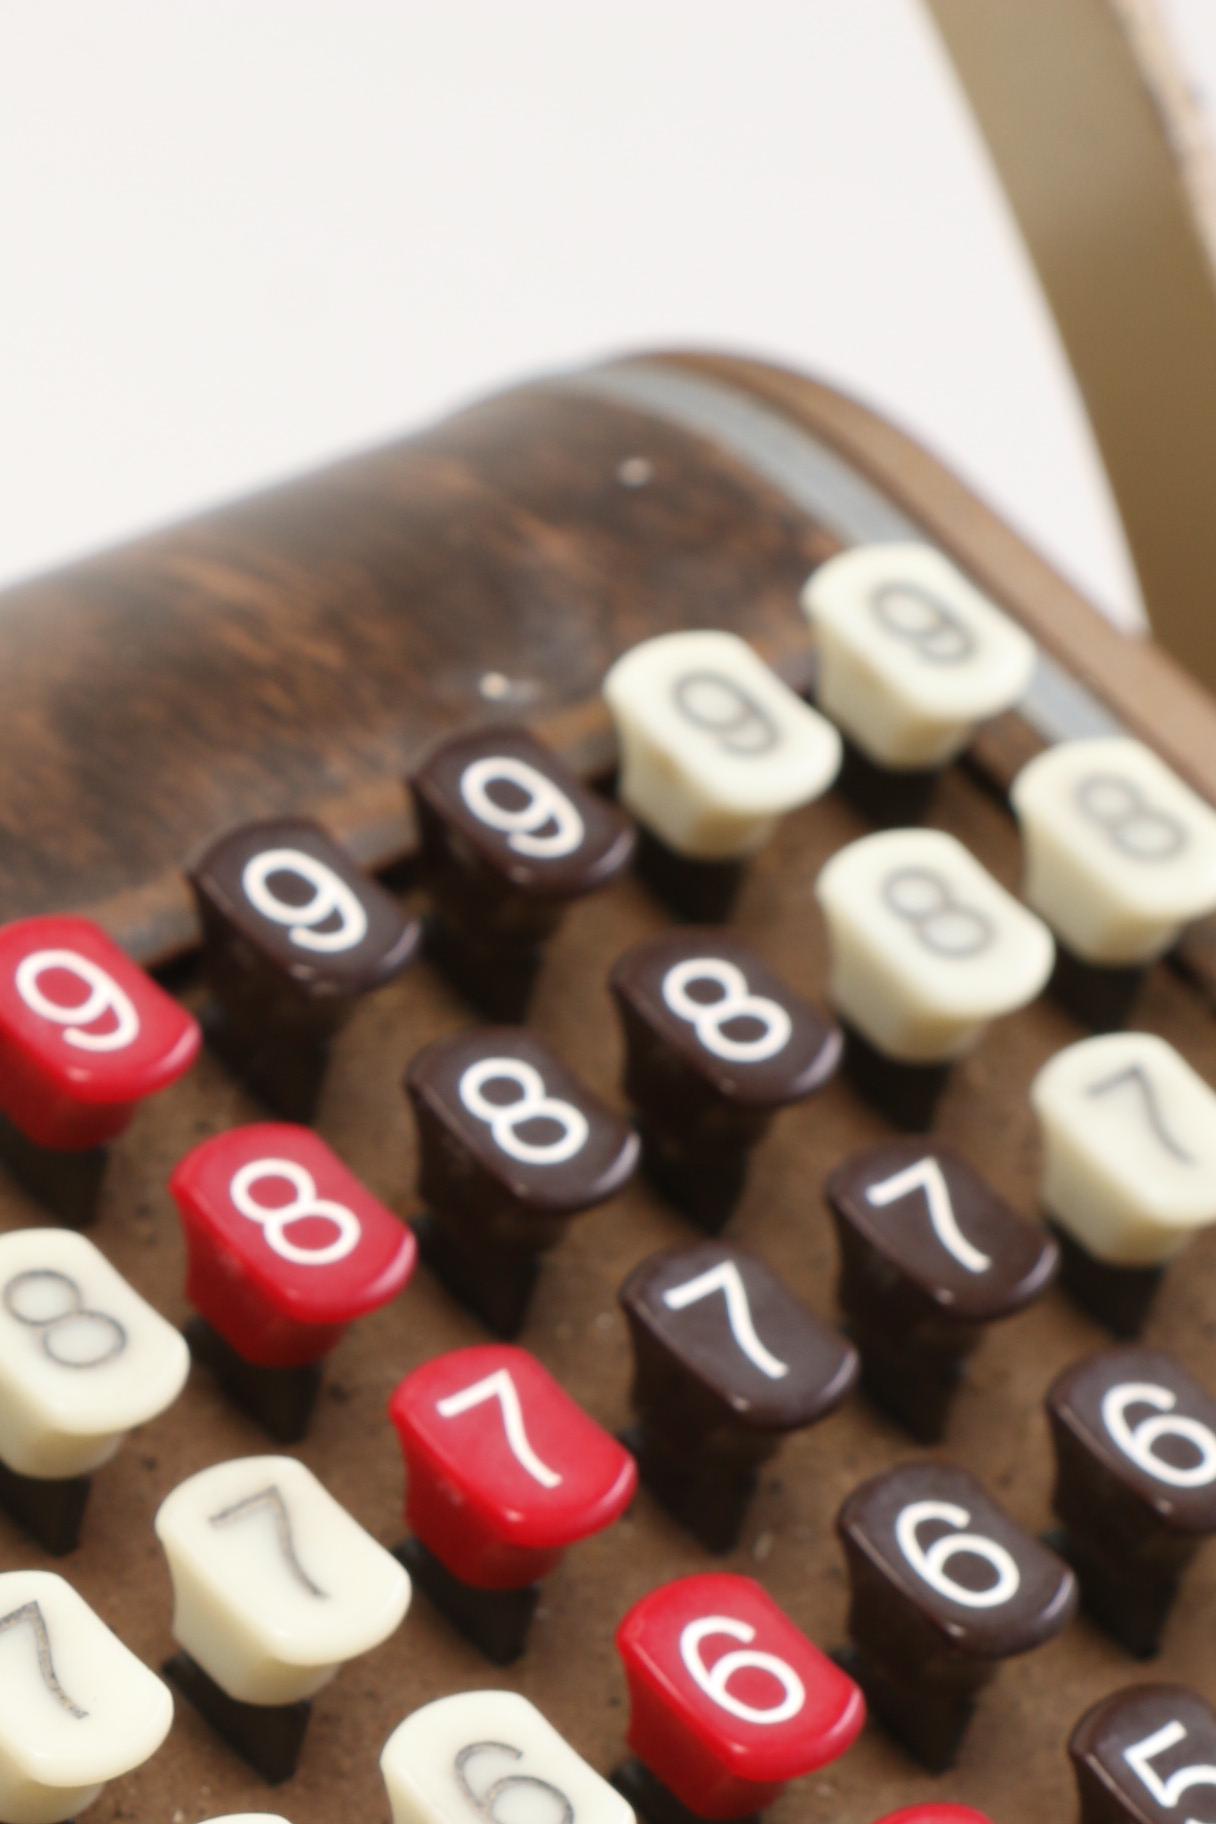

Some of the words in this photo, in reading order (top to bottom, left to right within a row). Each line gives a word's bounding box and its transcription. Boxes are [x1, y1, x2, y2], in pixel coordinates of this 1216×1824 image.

[866, 580, 978, 668] 9
[671, 669, 783, 758] 9
[462, 758, 582, 856] 9
[1071, 775, 1193, 863] 8
[244, 850, 366, 951] 9
[879, 866, 998, 960] 8
[16, 951, 138, 1050] 9
[664, 959, 790, 1061] 8
[460, 1059, 587, 1163] 8
[1085, 1061, 1194, 1166] 7
[231, 1159, 360, 1264] 8
[867, 1160, 987, 1271] 7
[2, 1268, 128, 1370] 8
[665, 1263, 786, 1377] 7
[438, 1370, 560, 1487] 7
[208, 1484, 329, 1601] 7
[897, 1502, 1018, 1607] 6
[0, 1600, 89, 1720] 7
[681, 1617, 804, 1724] 6
